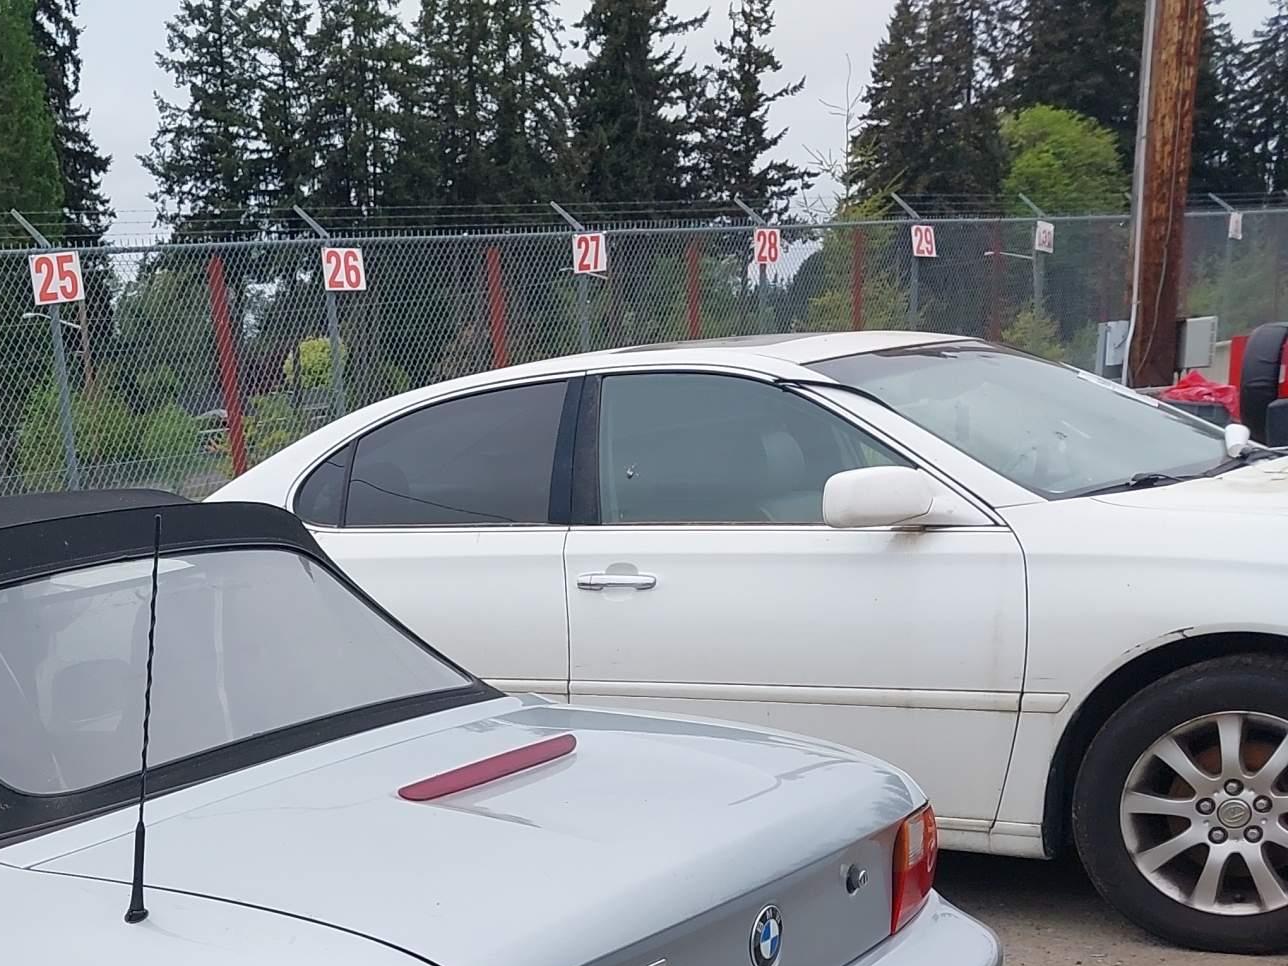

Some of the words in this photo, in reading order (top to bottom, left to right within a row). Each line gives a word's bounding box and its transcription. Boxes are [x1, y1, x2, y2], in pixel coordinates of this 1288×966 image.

[577, 235, 601, 272] 27
[757, 231, 778, 263] 28
[914, 226, 934, 255] 29
[34, 255, 79, 303] 25
[325, 250, 361, 289] 26
